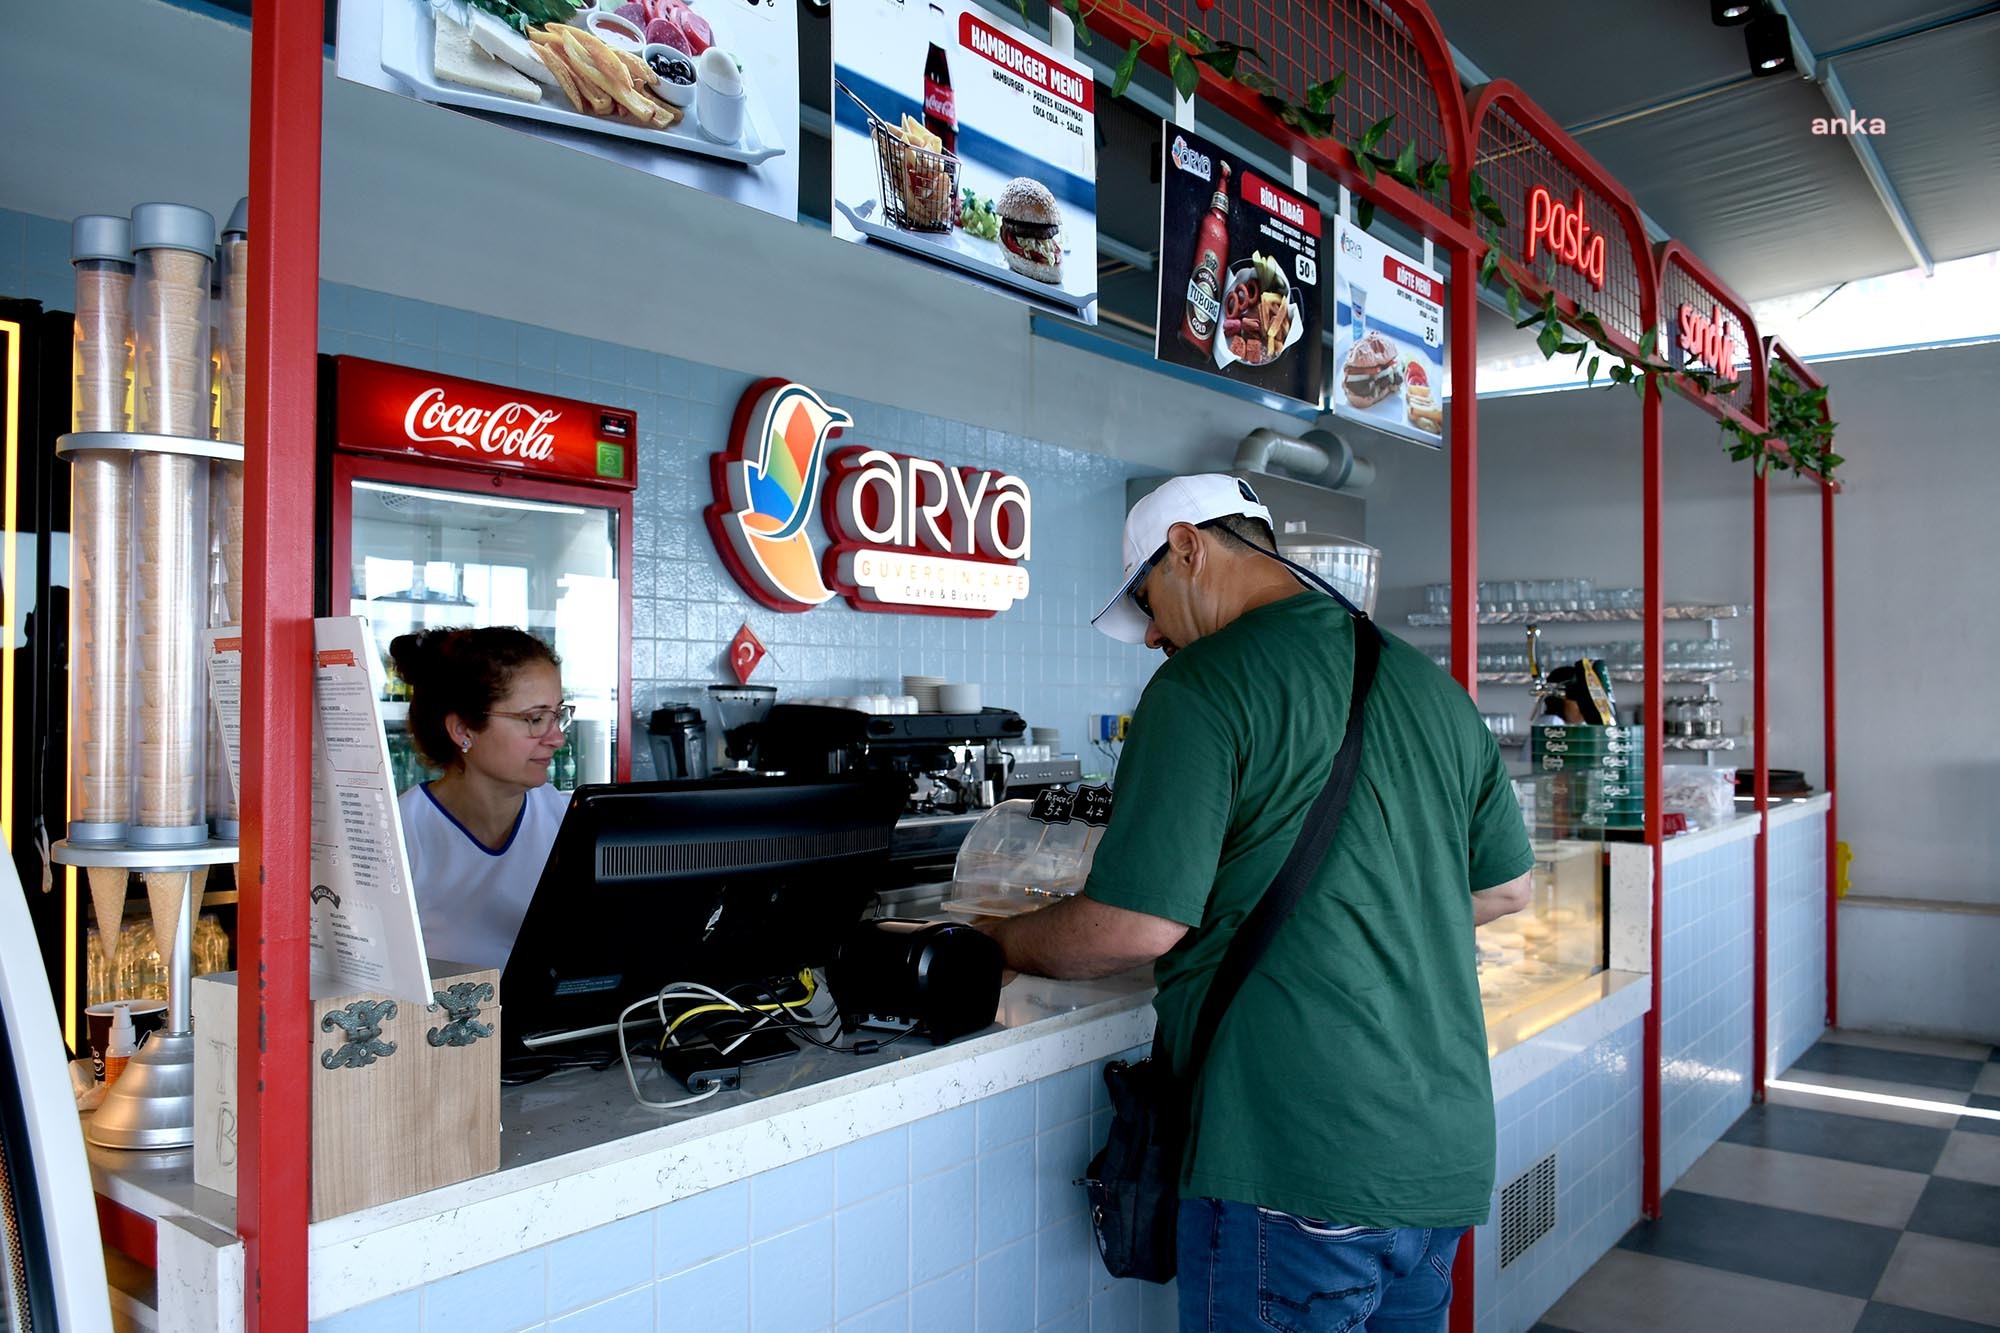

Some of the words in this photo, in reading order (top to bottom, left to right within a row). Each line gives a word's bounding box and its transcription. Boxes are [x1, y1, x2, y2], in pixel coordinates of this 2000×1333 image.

[970, 24, 1048, 85] HAMBURGER
[1050, 68, 1084, 103] MENÜ
[992, 69, 1025, 94] HAMBURGER
[1033, 90, 1053, 109] PATATES
[1032, 104, 1046, 119] COCA
[1046, 111, 1059, 126] COLA
[1066, 121, 1084, 137] SALATA
[1529, 187, 1606, 289] pasta
[1299, 261, 1310, 279] 50
[1188, 284, 1219, 318] TUBORG
[1191, 317, 1207, 335] GOLD
[1426, 326, 1434, 342] 35
[404, 388, 562, 461] Coca-Cola
